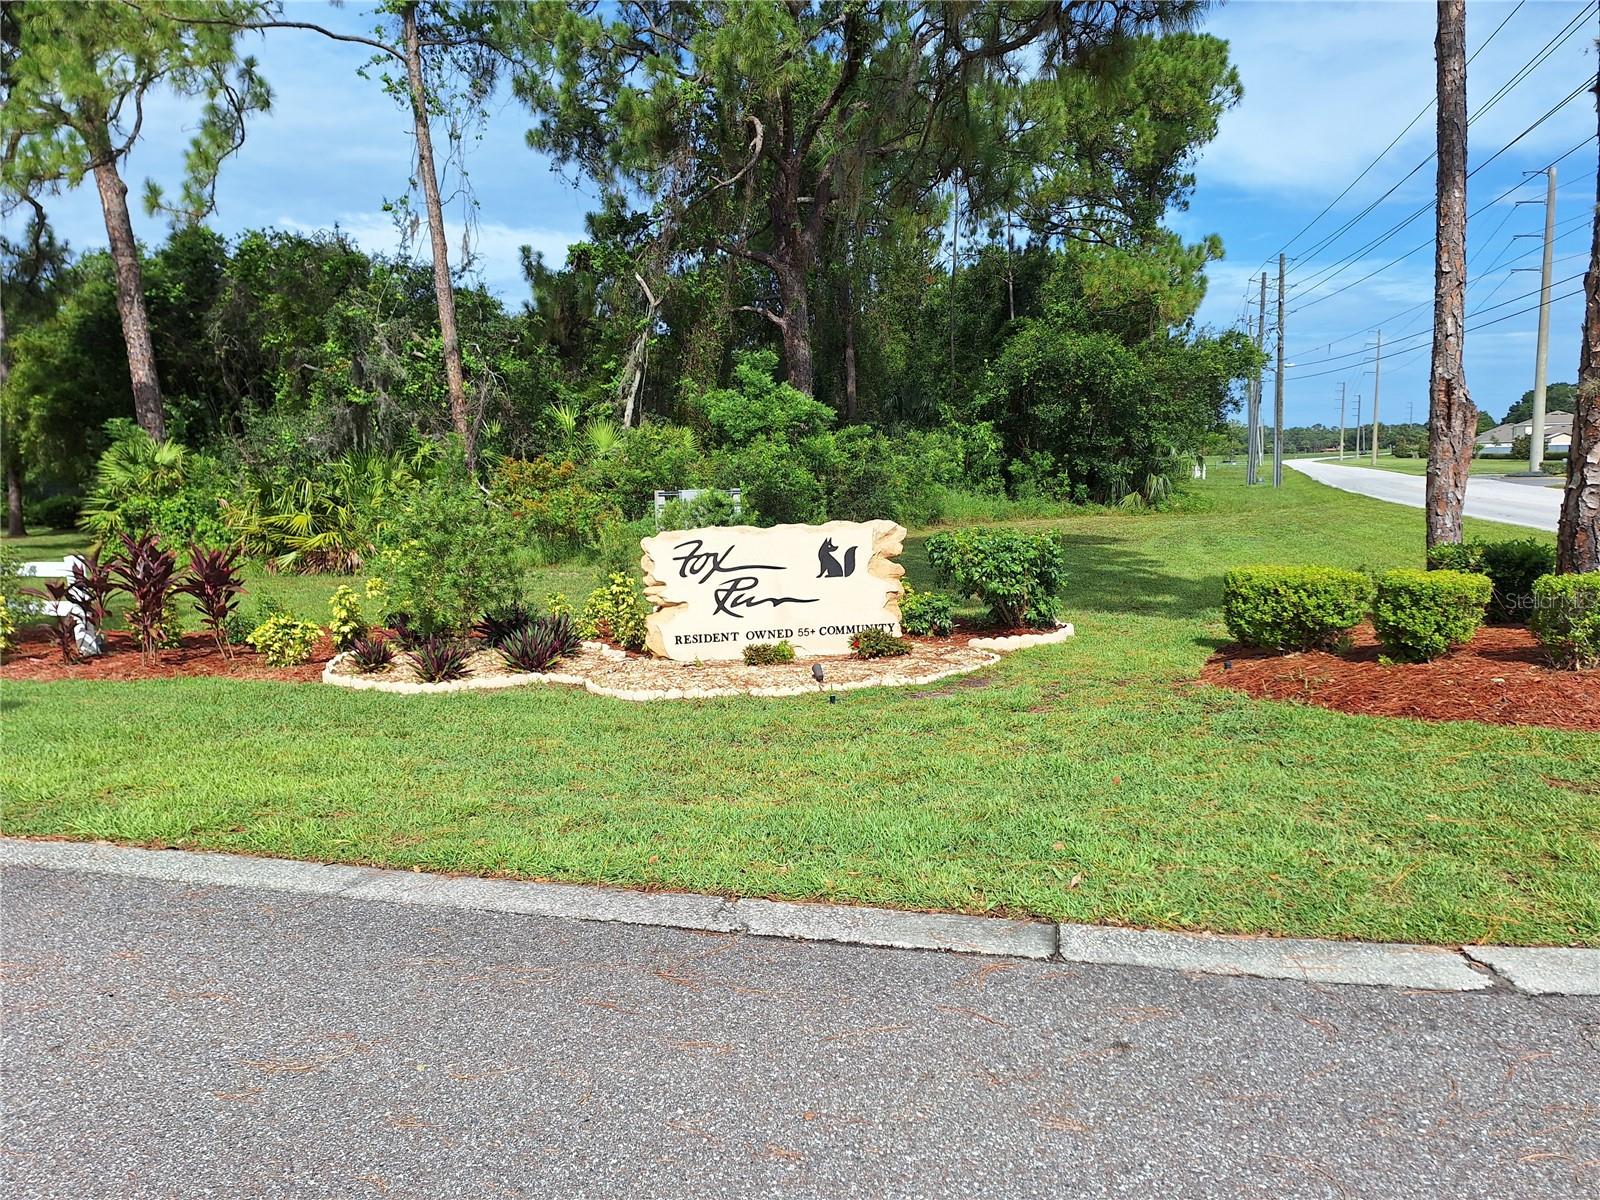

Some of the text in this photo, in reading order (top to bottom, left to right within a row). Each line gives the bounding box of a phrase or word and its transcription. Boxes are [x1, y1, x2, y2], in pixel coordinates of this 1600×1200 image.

[673, 540, 787, 584] Fox
[712, 576, 820, 618] Run
[675, 631, 740, 645] RESIDENT
[745, 628, 794, 640] OWNED
[797, 627, 816, 637] 55+
